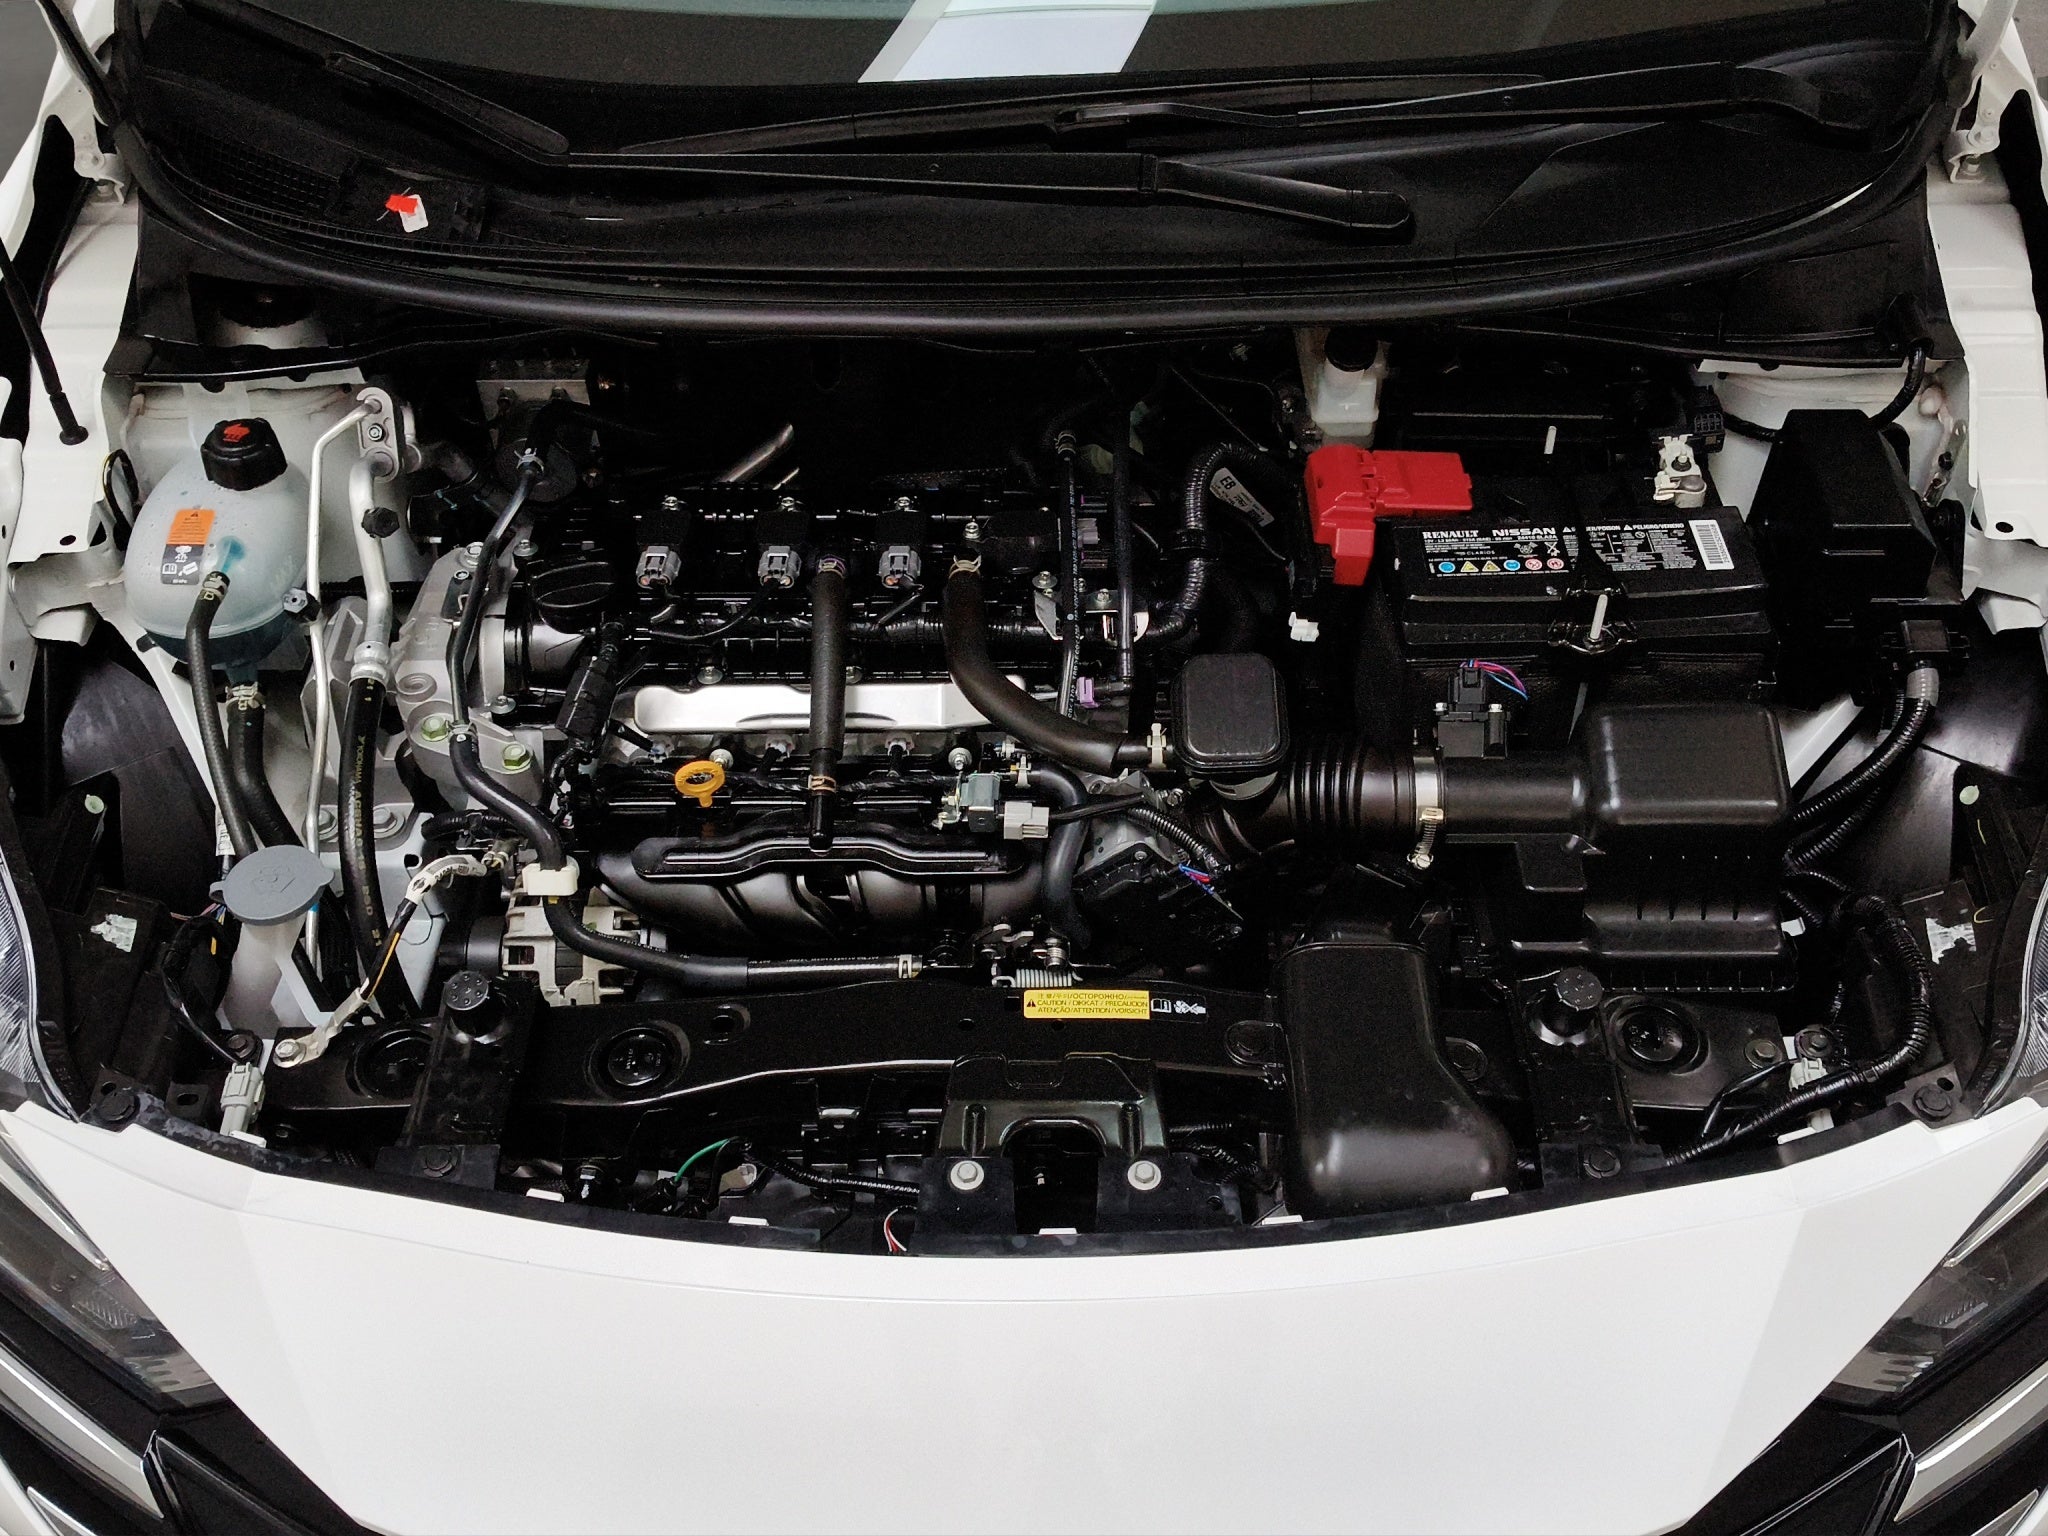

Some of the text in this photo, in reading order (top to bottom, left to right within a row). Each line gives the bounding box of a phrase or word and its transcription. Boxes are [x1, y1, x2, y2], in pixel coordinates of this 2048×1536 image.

[1220, 476, 1236, 490] EB
[1422, 530, 1479, 539] RENAULT
[1491, 527, 1557, 537] NISSAN
[354, 745, 365, 784] YOKOHAMA
